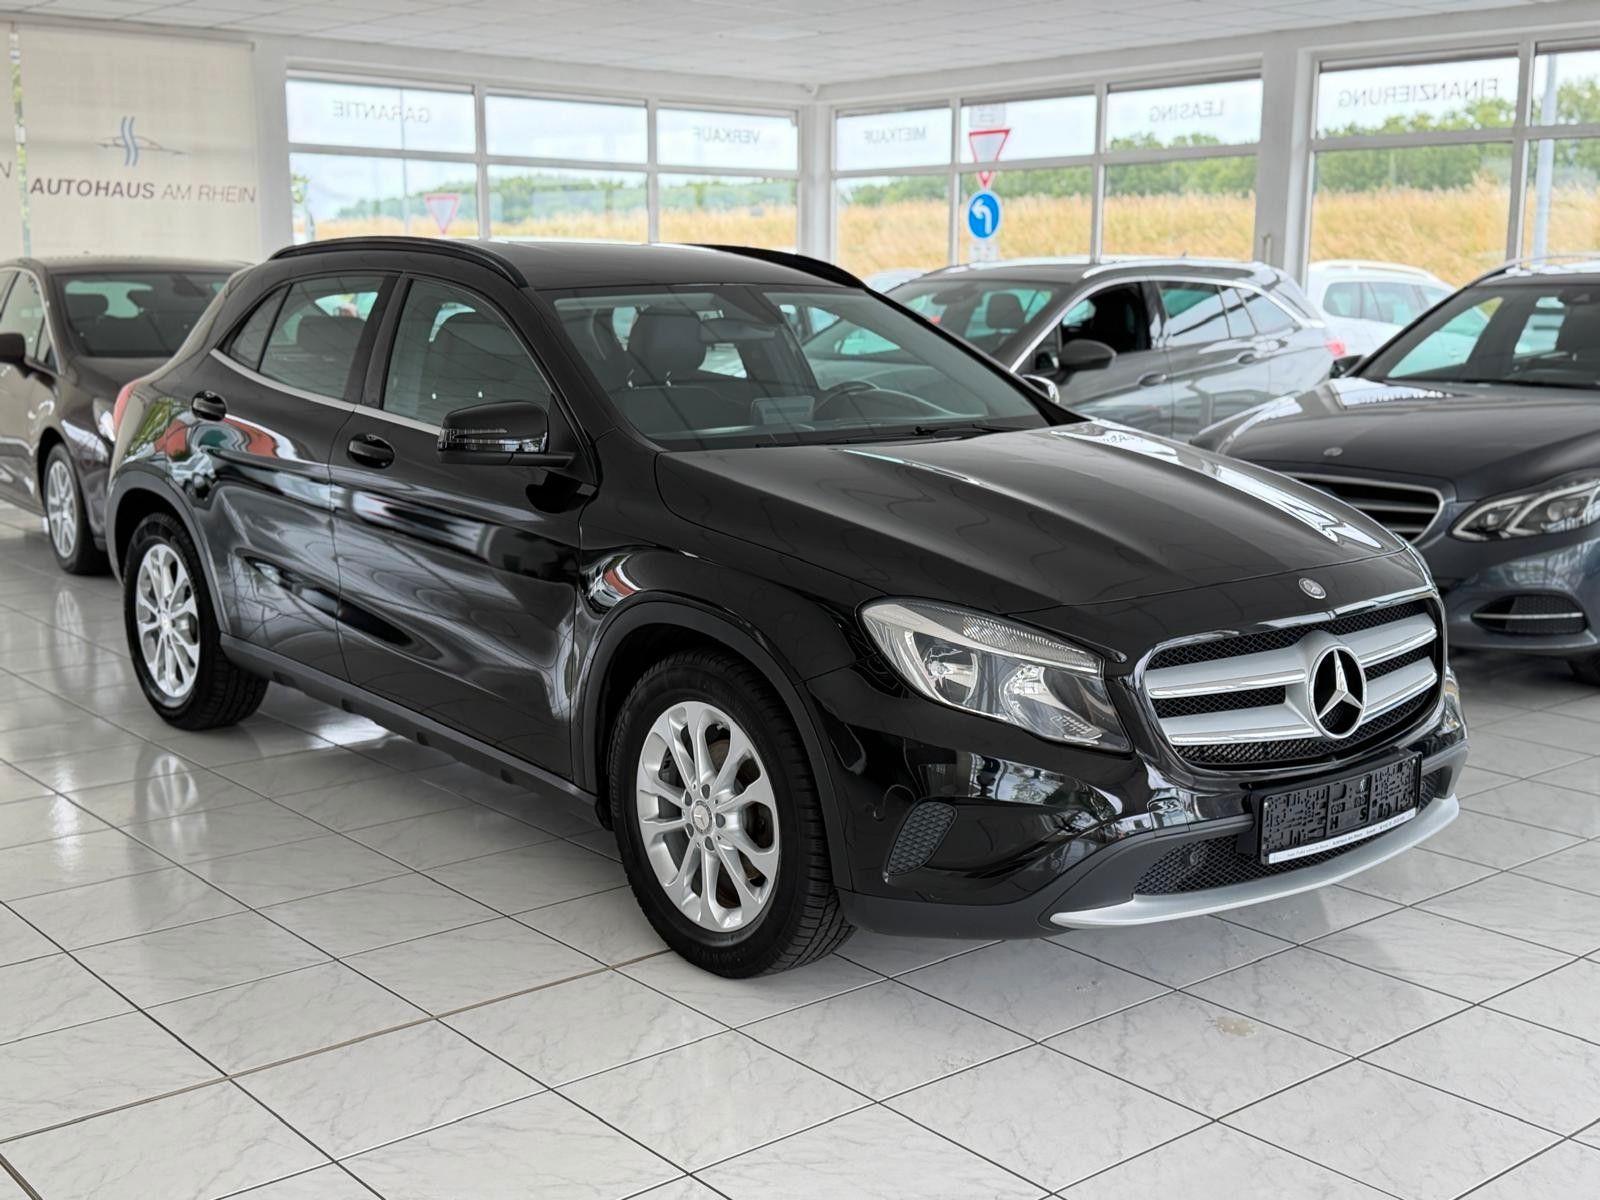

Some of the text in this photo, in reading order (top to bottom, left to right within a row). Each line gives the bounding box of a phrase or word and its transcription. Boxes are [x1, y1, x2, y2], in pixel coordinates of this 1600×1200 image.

[30, 177, 256, 204] AUTOHAUS AM RHEIN
